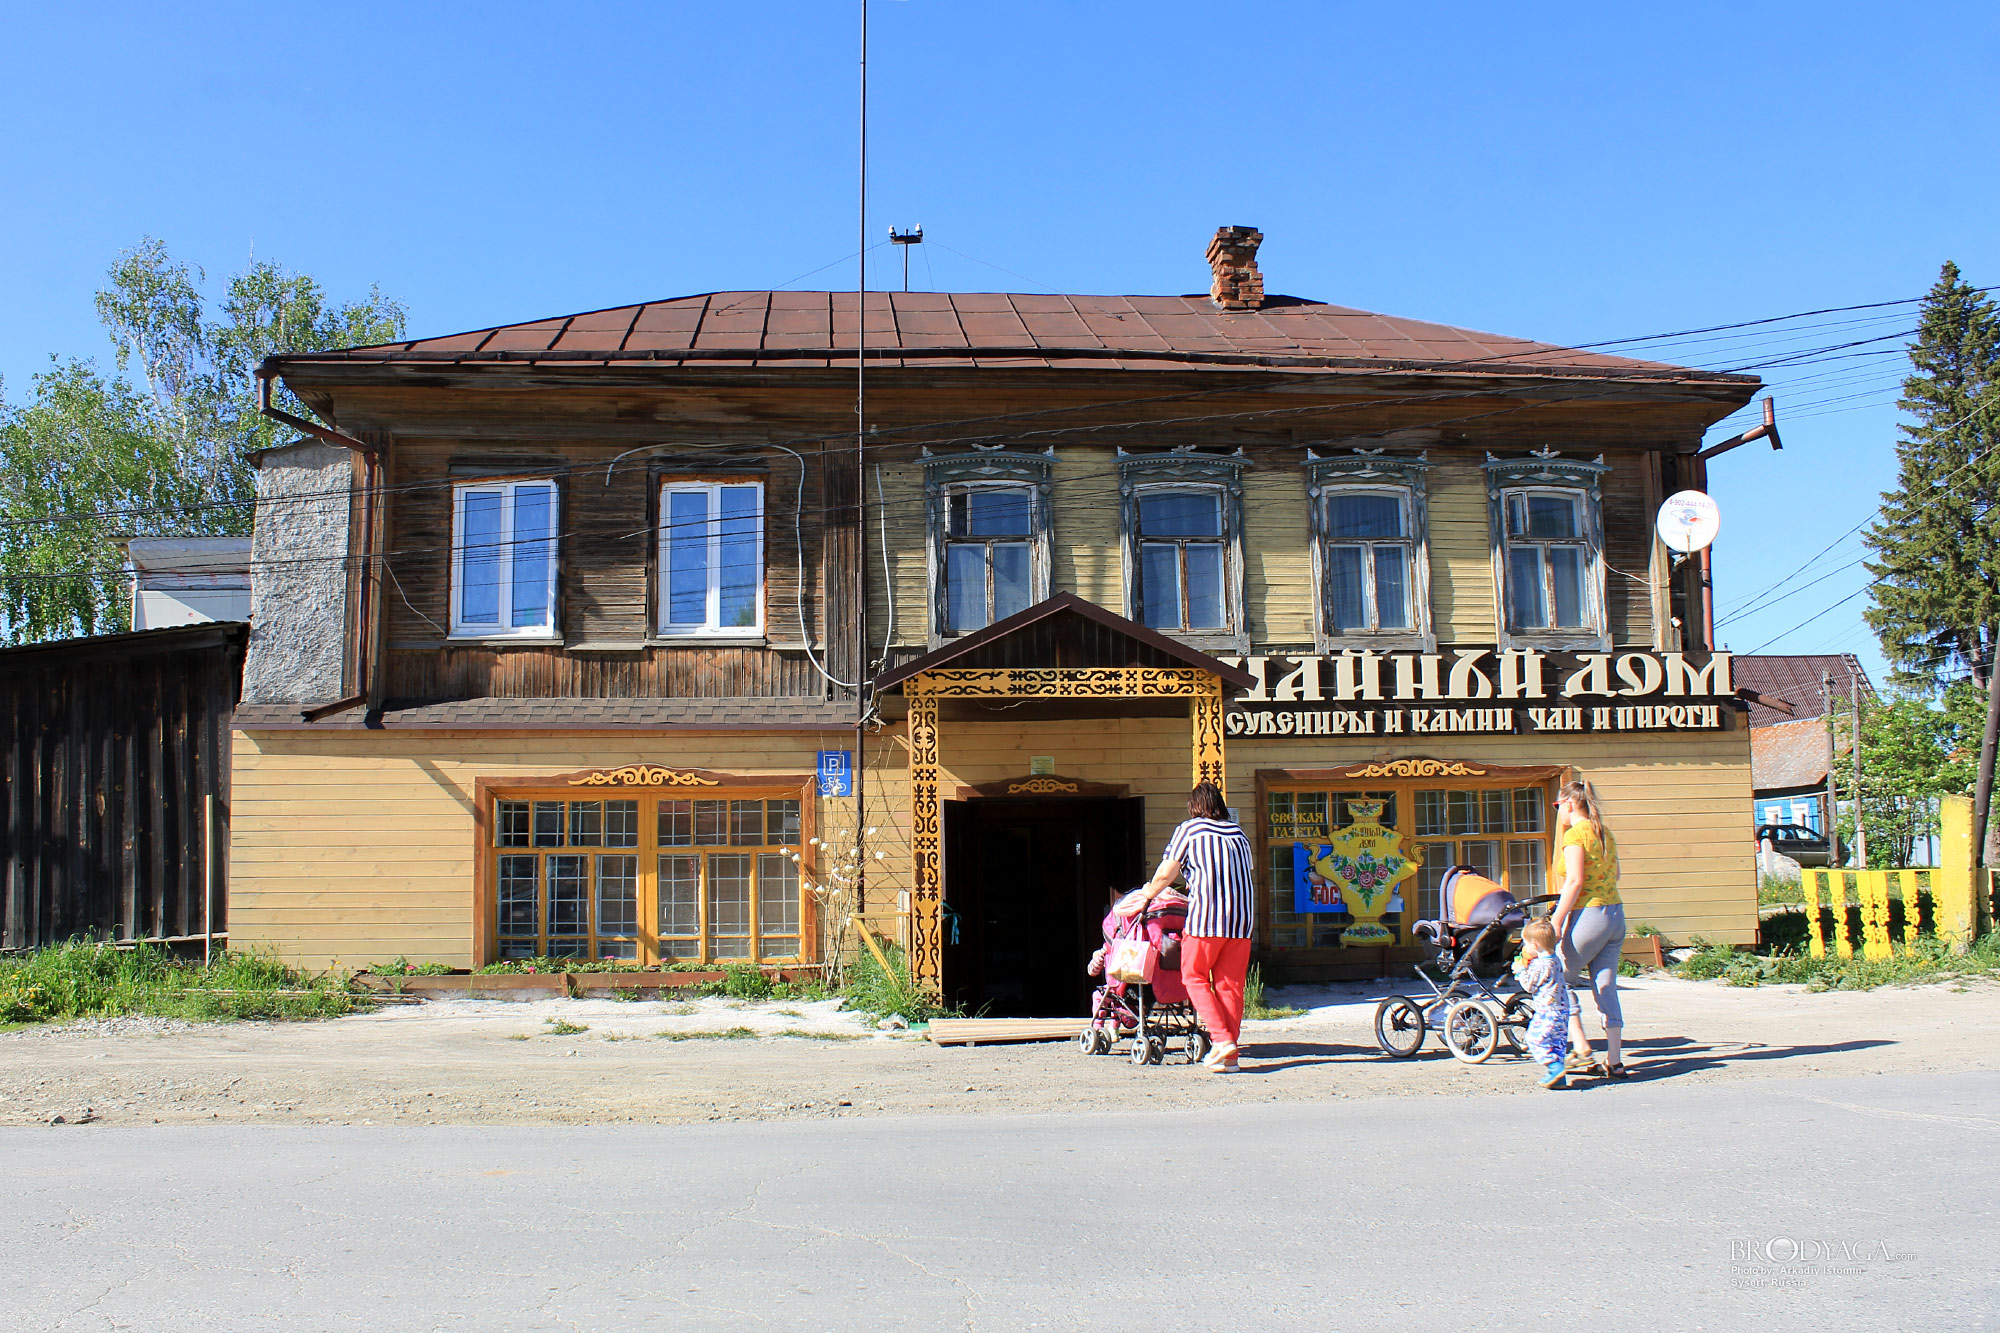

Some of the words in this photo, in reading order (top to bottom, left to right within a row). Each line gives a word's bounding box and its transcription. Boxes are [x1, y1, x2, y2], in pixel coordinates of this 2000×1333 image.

[1560, 653, 1735, 698] ДОМ
[1226, 710, 1375, 735] СУВЕНИРЫ
[1384, 709, 1403, 733] И
[1411, 708, 1514, 732] КАМНИ
[1592, 706, 1611, 730] И
[1616, 705, 1719, 730] ПИРОГИ
[1270, 812, 1324, 824] СВЕЖАЯ
[1273, 826, 1321, 838] ГАЗЕТА
